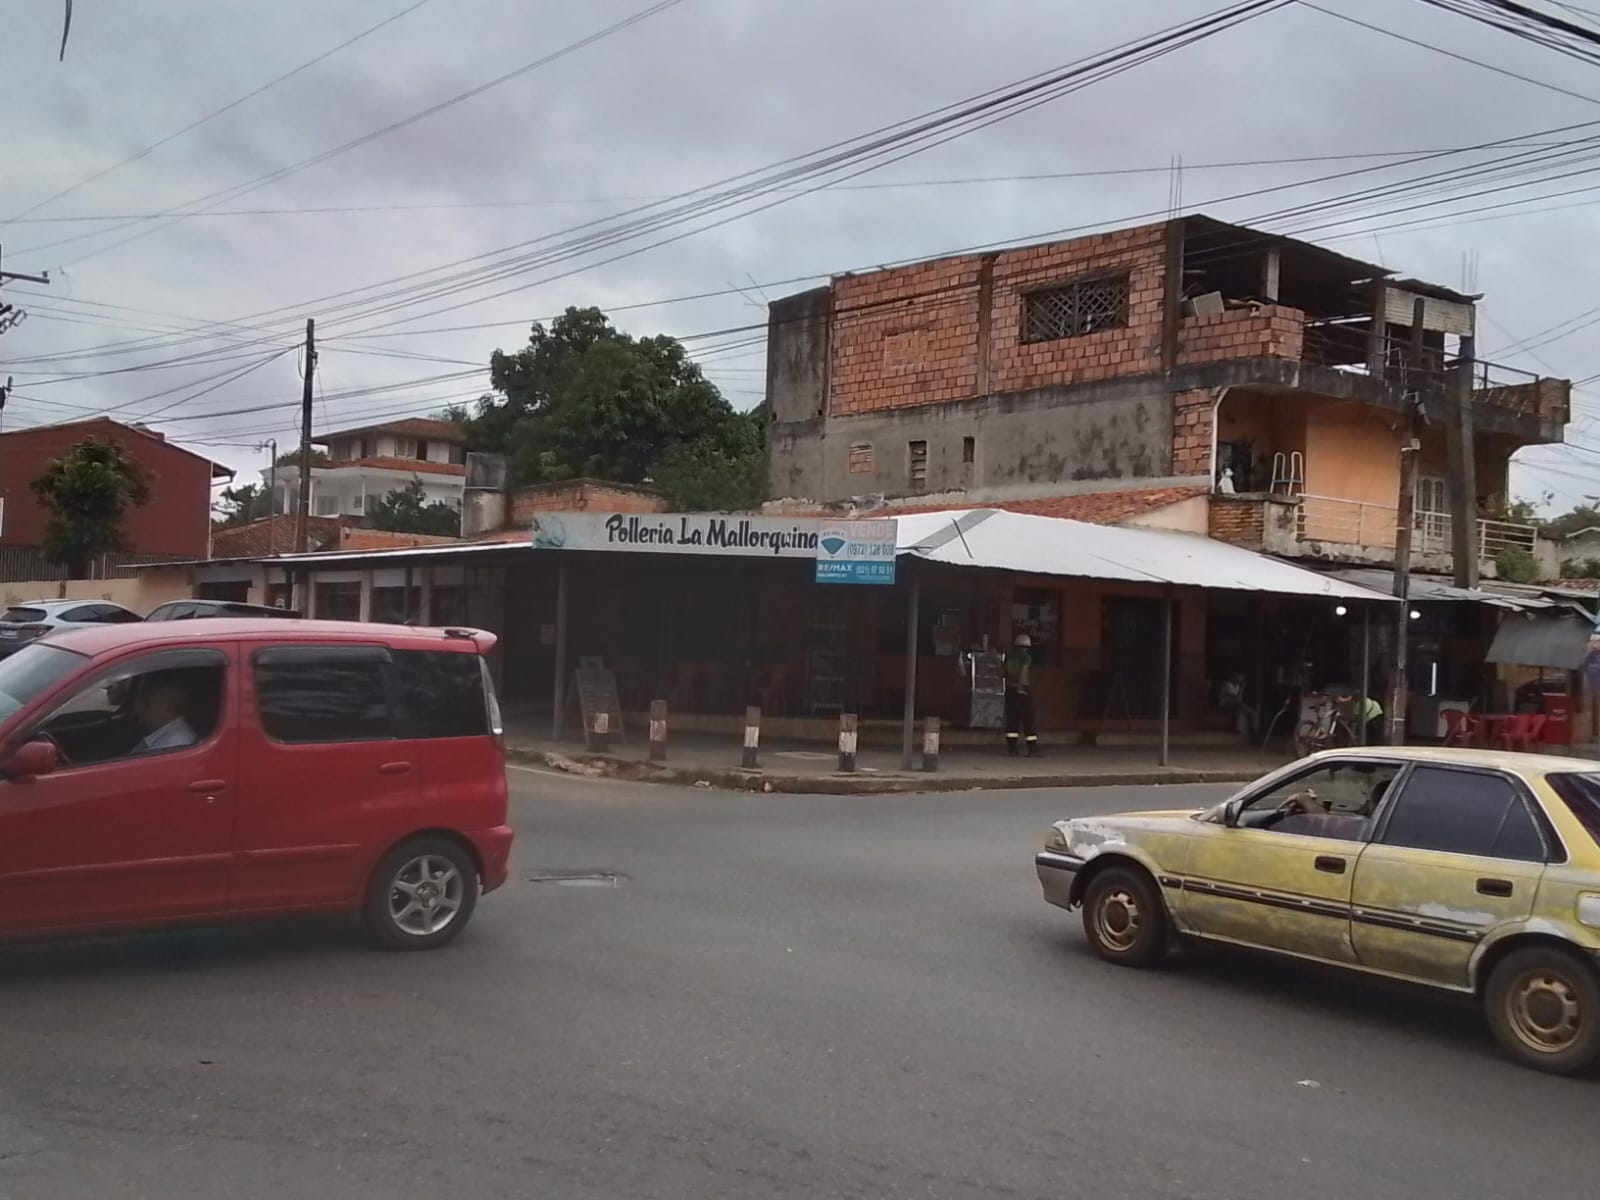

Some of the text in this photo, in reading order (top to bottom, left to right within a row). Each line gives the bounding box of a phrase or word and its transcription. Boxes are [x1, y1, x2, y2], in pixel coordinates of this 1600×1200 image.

[605, 513, 818, 554] Polleria La Mallorquina
[849, 523, 894, 538] VENDE
